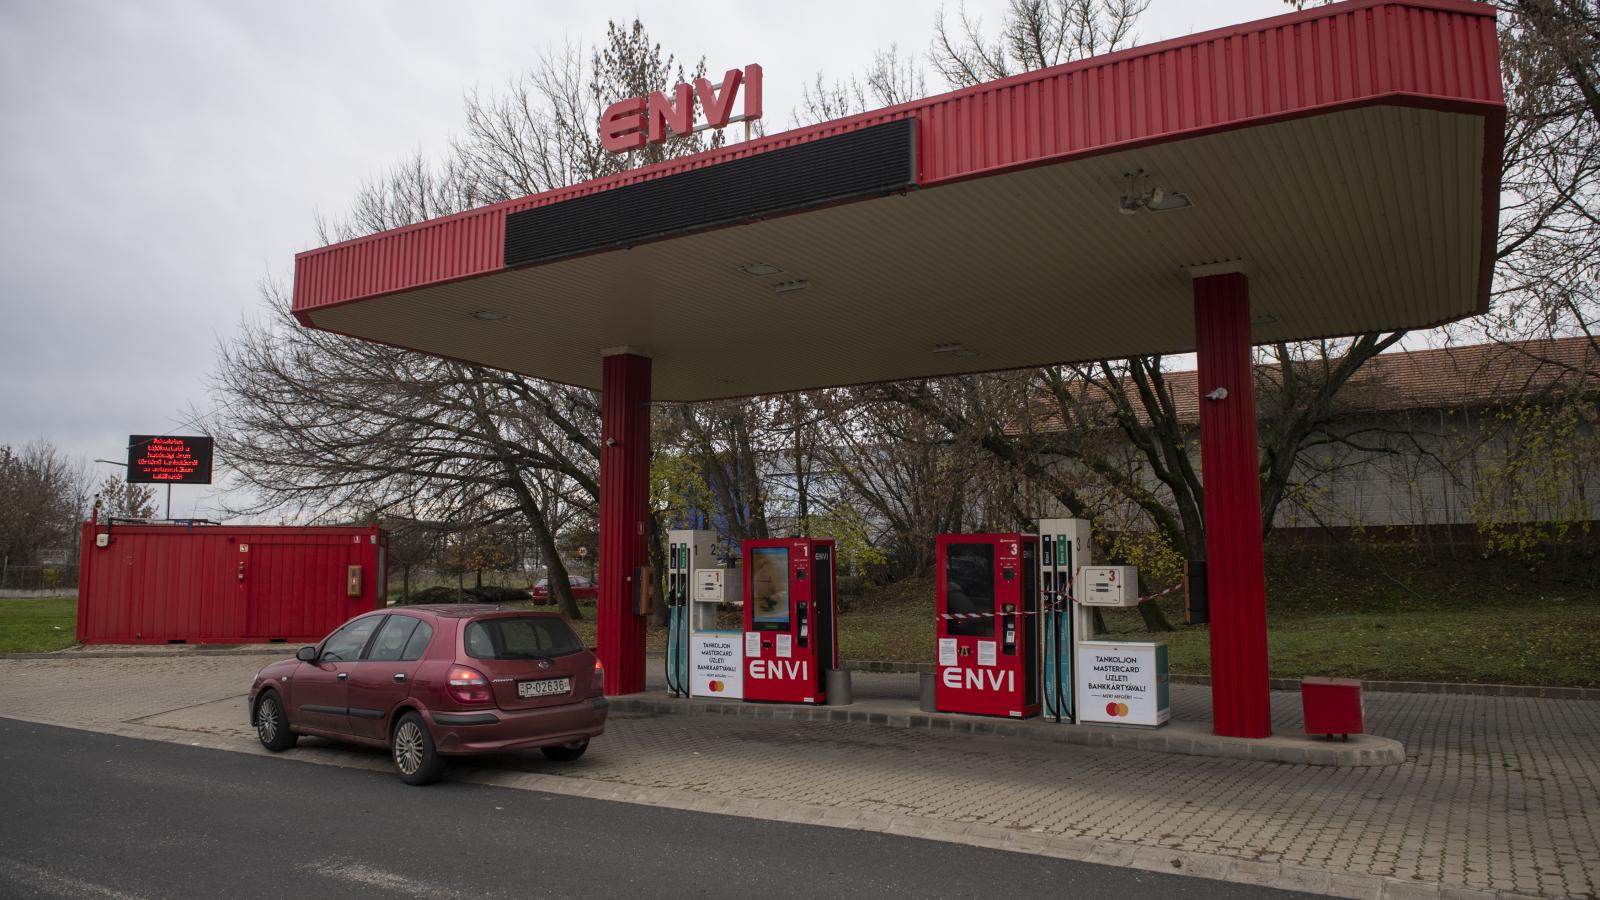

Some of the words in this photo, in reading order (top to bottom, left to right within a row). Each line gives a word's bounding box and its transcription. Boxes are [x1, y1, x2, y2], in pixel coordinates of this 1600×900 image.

[600, 63, 763, 154] ENVI
[694, 544, 698, 556] 1
[711, 543, 716, 555] 2
[803, 545, 808, 557] 1
[1010, 543, 1018, 556] 3
[715, 572, 720, 582] 1
[1108, 570, 1116, 582] 3
[1095, 655, 1137, 664] TANKOLJON
[749, 659, 808, 681] ENVI
[1093, 665, 1140, 673] MASTERCARD
[943, 667, 1015, 692] ENVI
[1088, 682, 1146, 692] BANKKÁRTYÁVAL!
